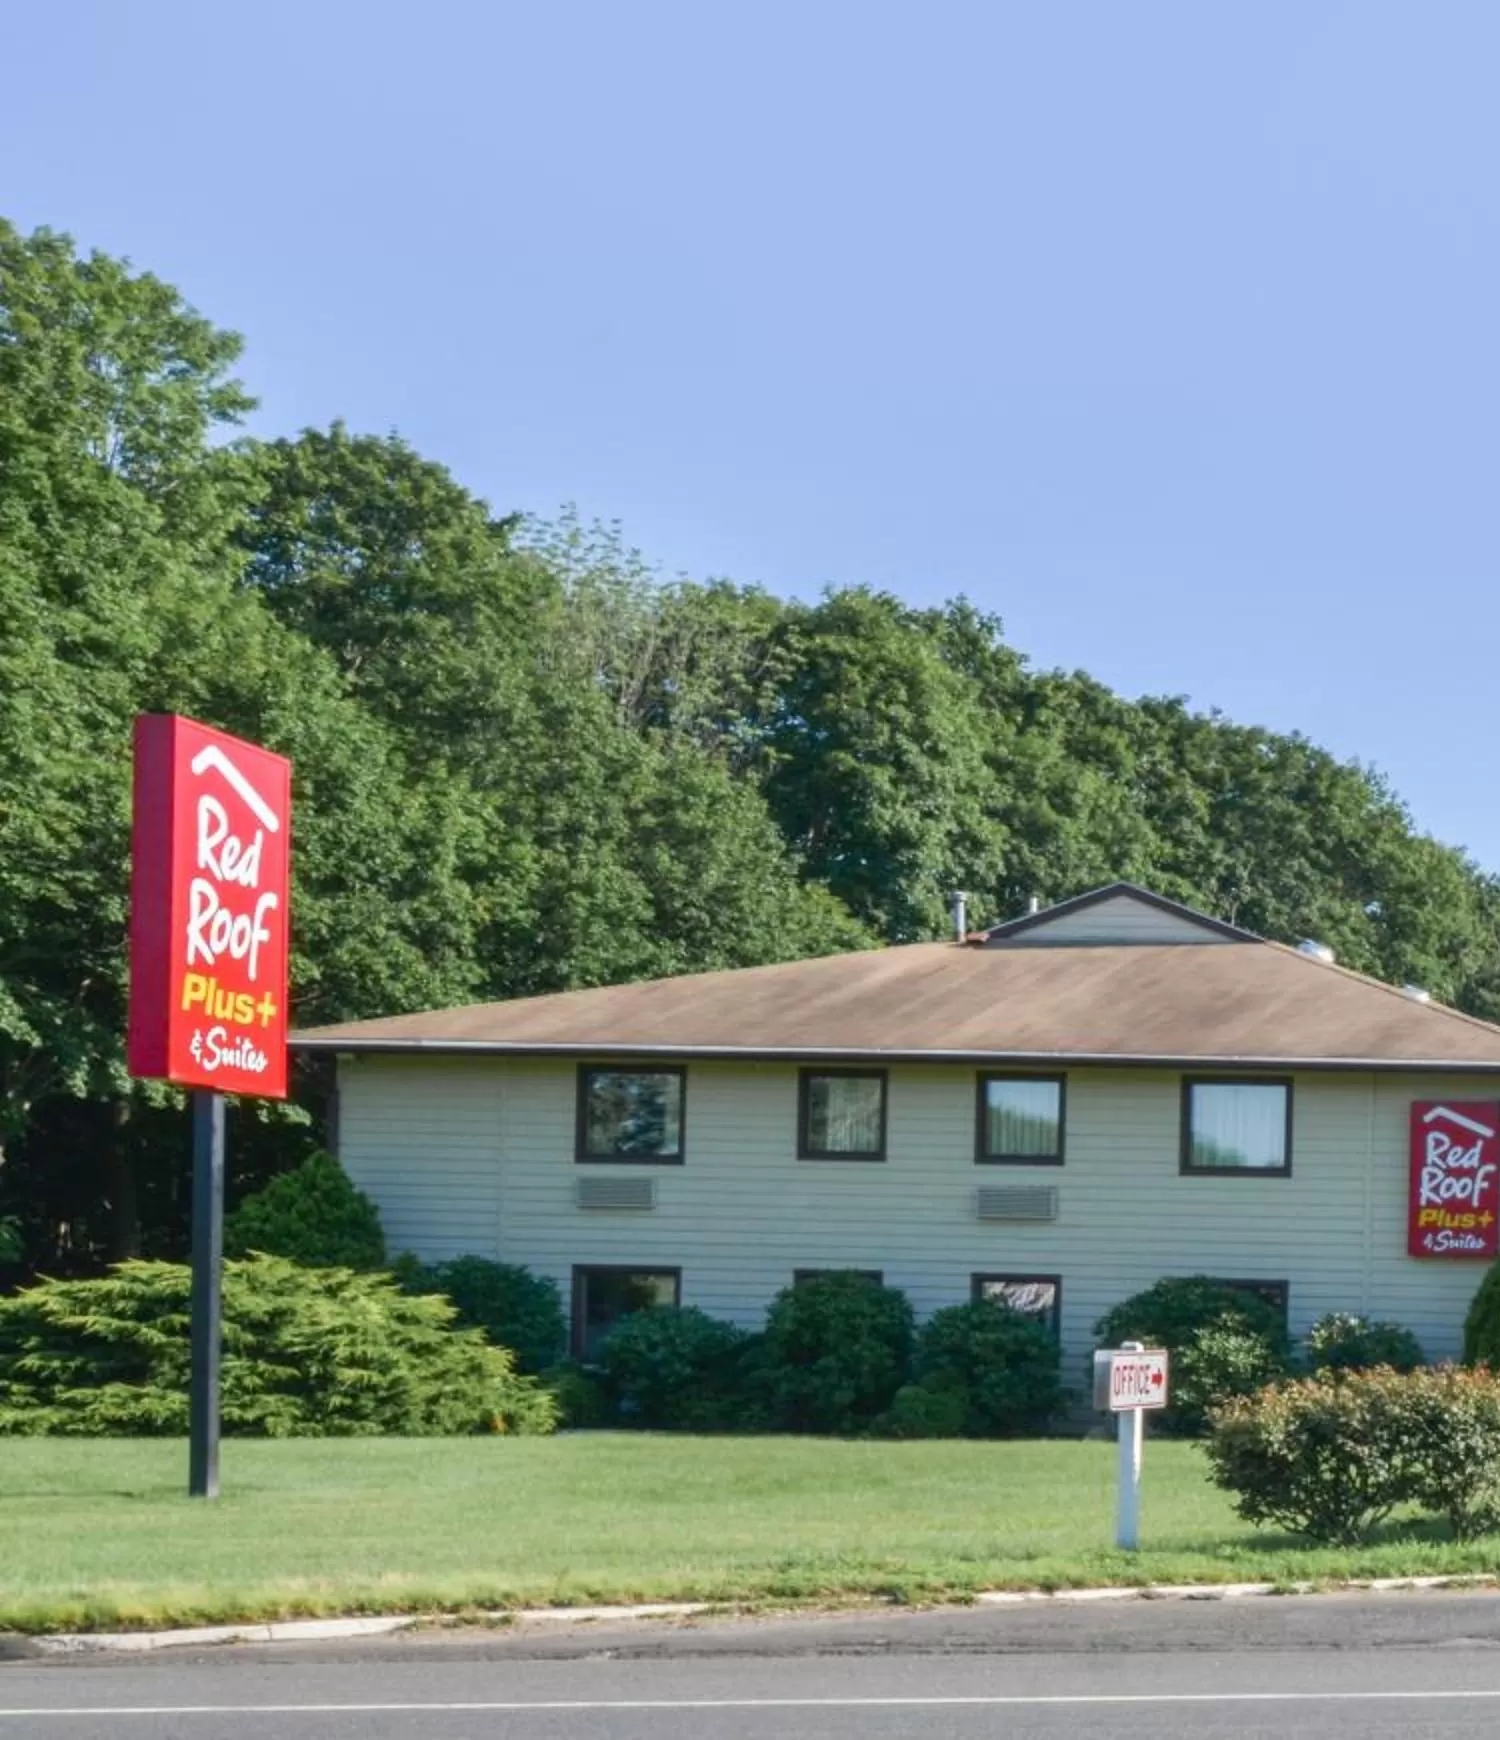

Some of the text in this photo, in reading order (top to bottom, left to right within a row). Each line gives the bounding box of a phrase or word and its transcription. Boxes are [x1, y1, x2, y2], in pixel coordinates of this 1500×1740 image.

[197, 794, 263, 888] Red
[187, 877, 277, 981] Roof
[182, 972, 277, 1028] Plus+
[1426, 1131, 1484, 1169] Red
[1420, 1164, 1497, 1207] Roof
[1418, 1208, 1494, 1228] Plus+
[1113, 1364, 1151, 1397] OFFICE
